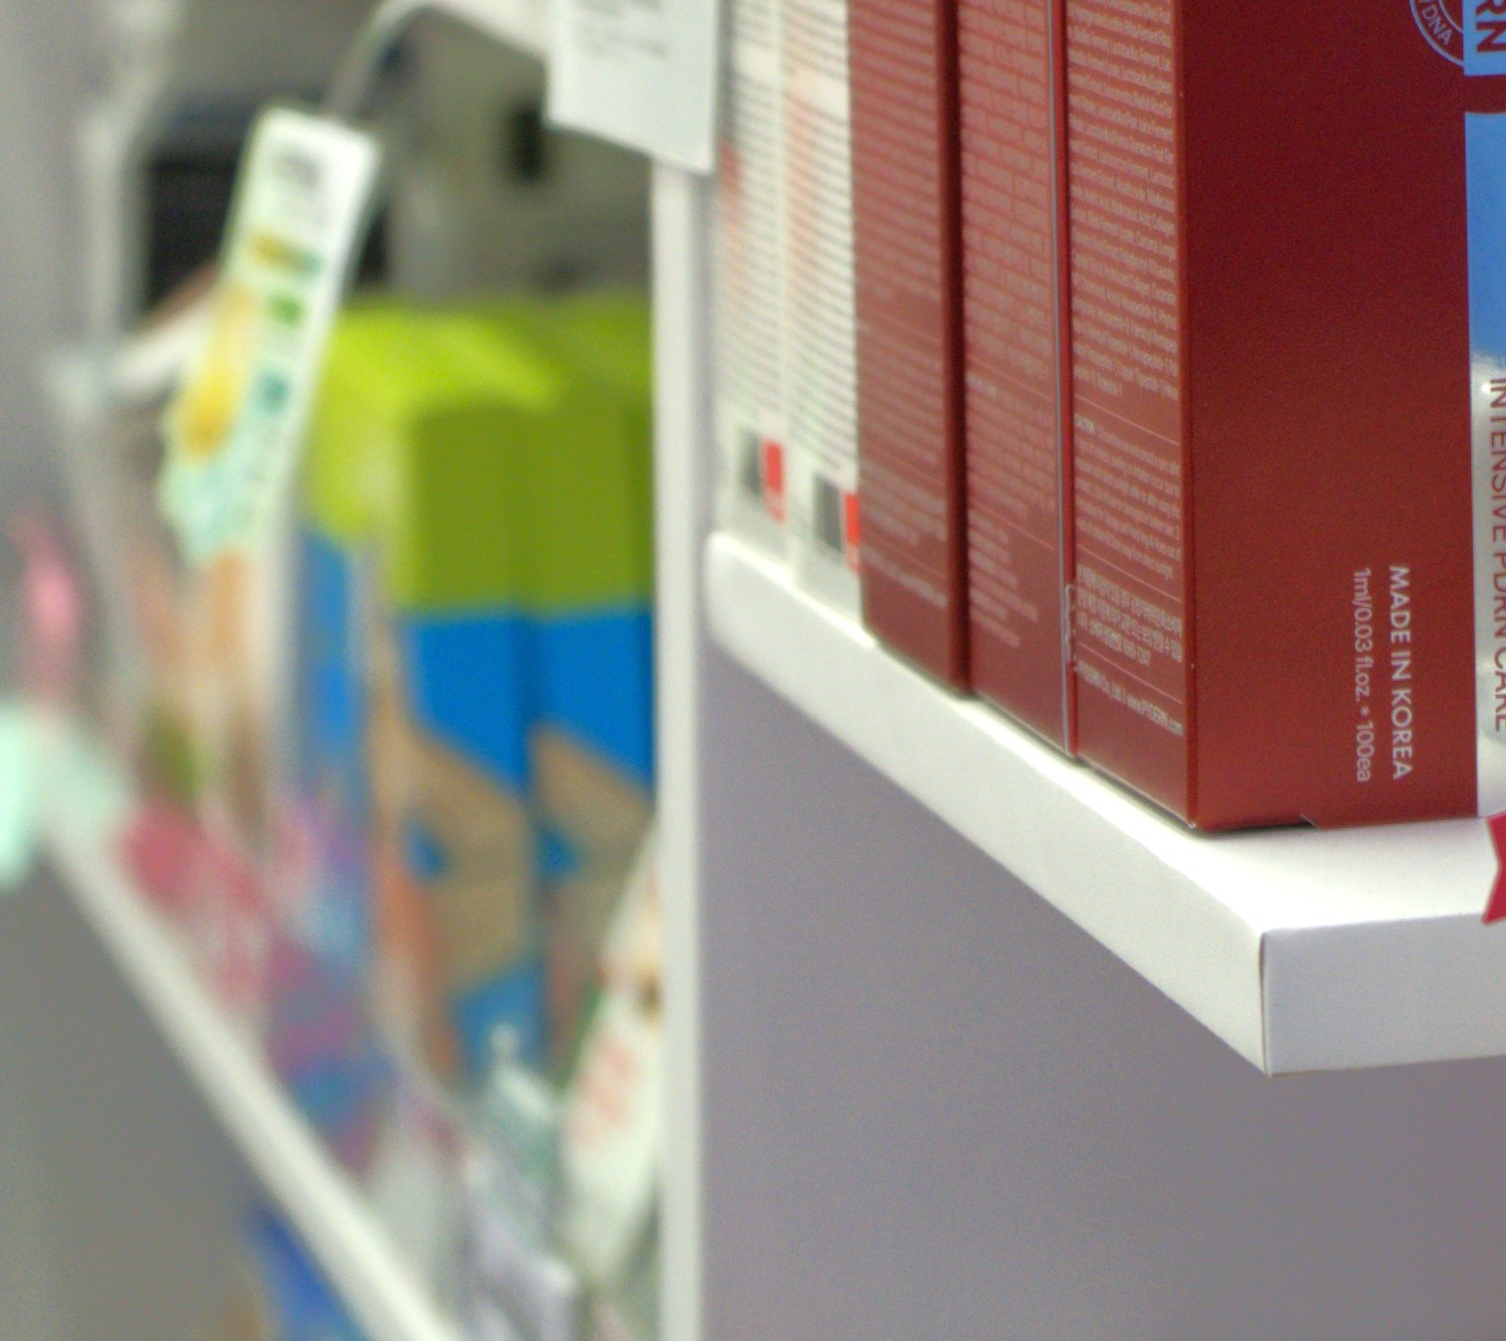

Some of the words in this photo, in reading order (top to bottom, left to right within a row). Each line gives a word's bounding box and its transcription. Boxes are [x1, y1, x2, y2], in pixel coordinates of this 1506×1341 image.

[1420, 1, 1453, 47] DNA
[1352, 567, 1373, 653] 1ml/0.03
[1389, 565, 1411, 644] MADE
[1391, 650, 1412, 682] IN
[1356, 719, 1375, 783] 100ea
[1391, 688, 1413, 780] KOREA
